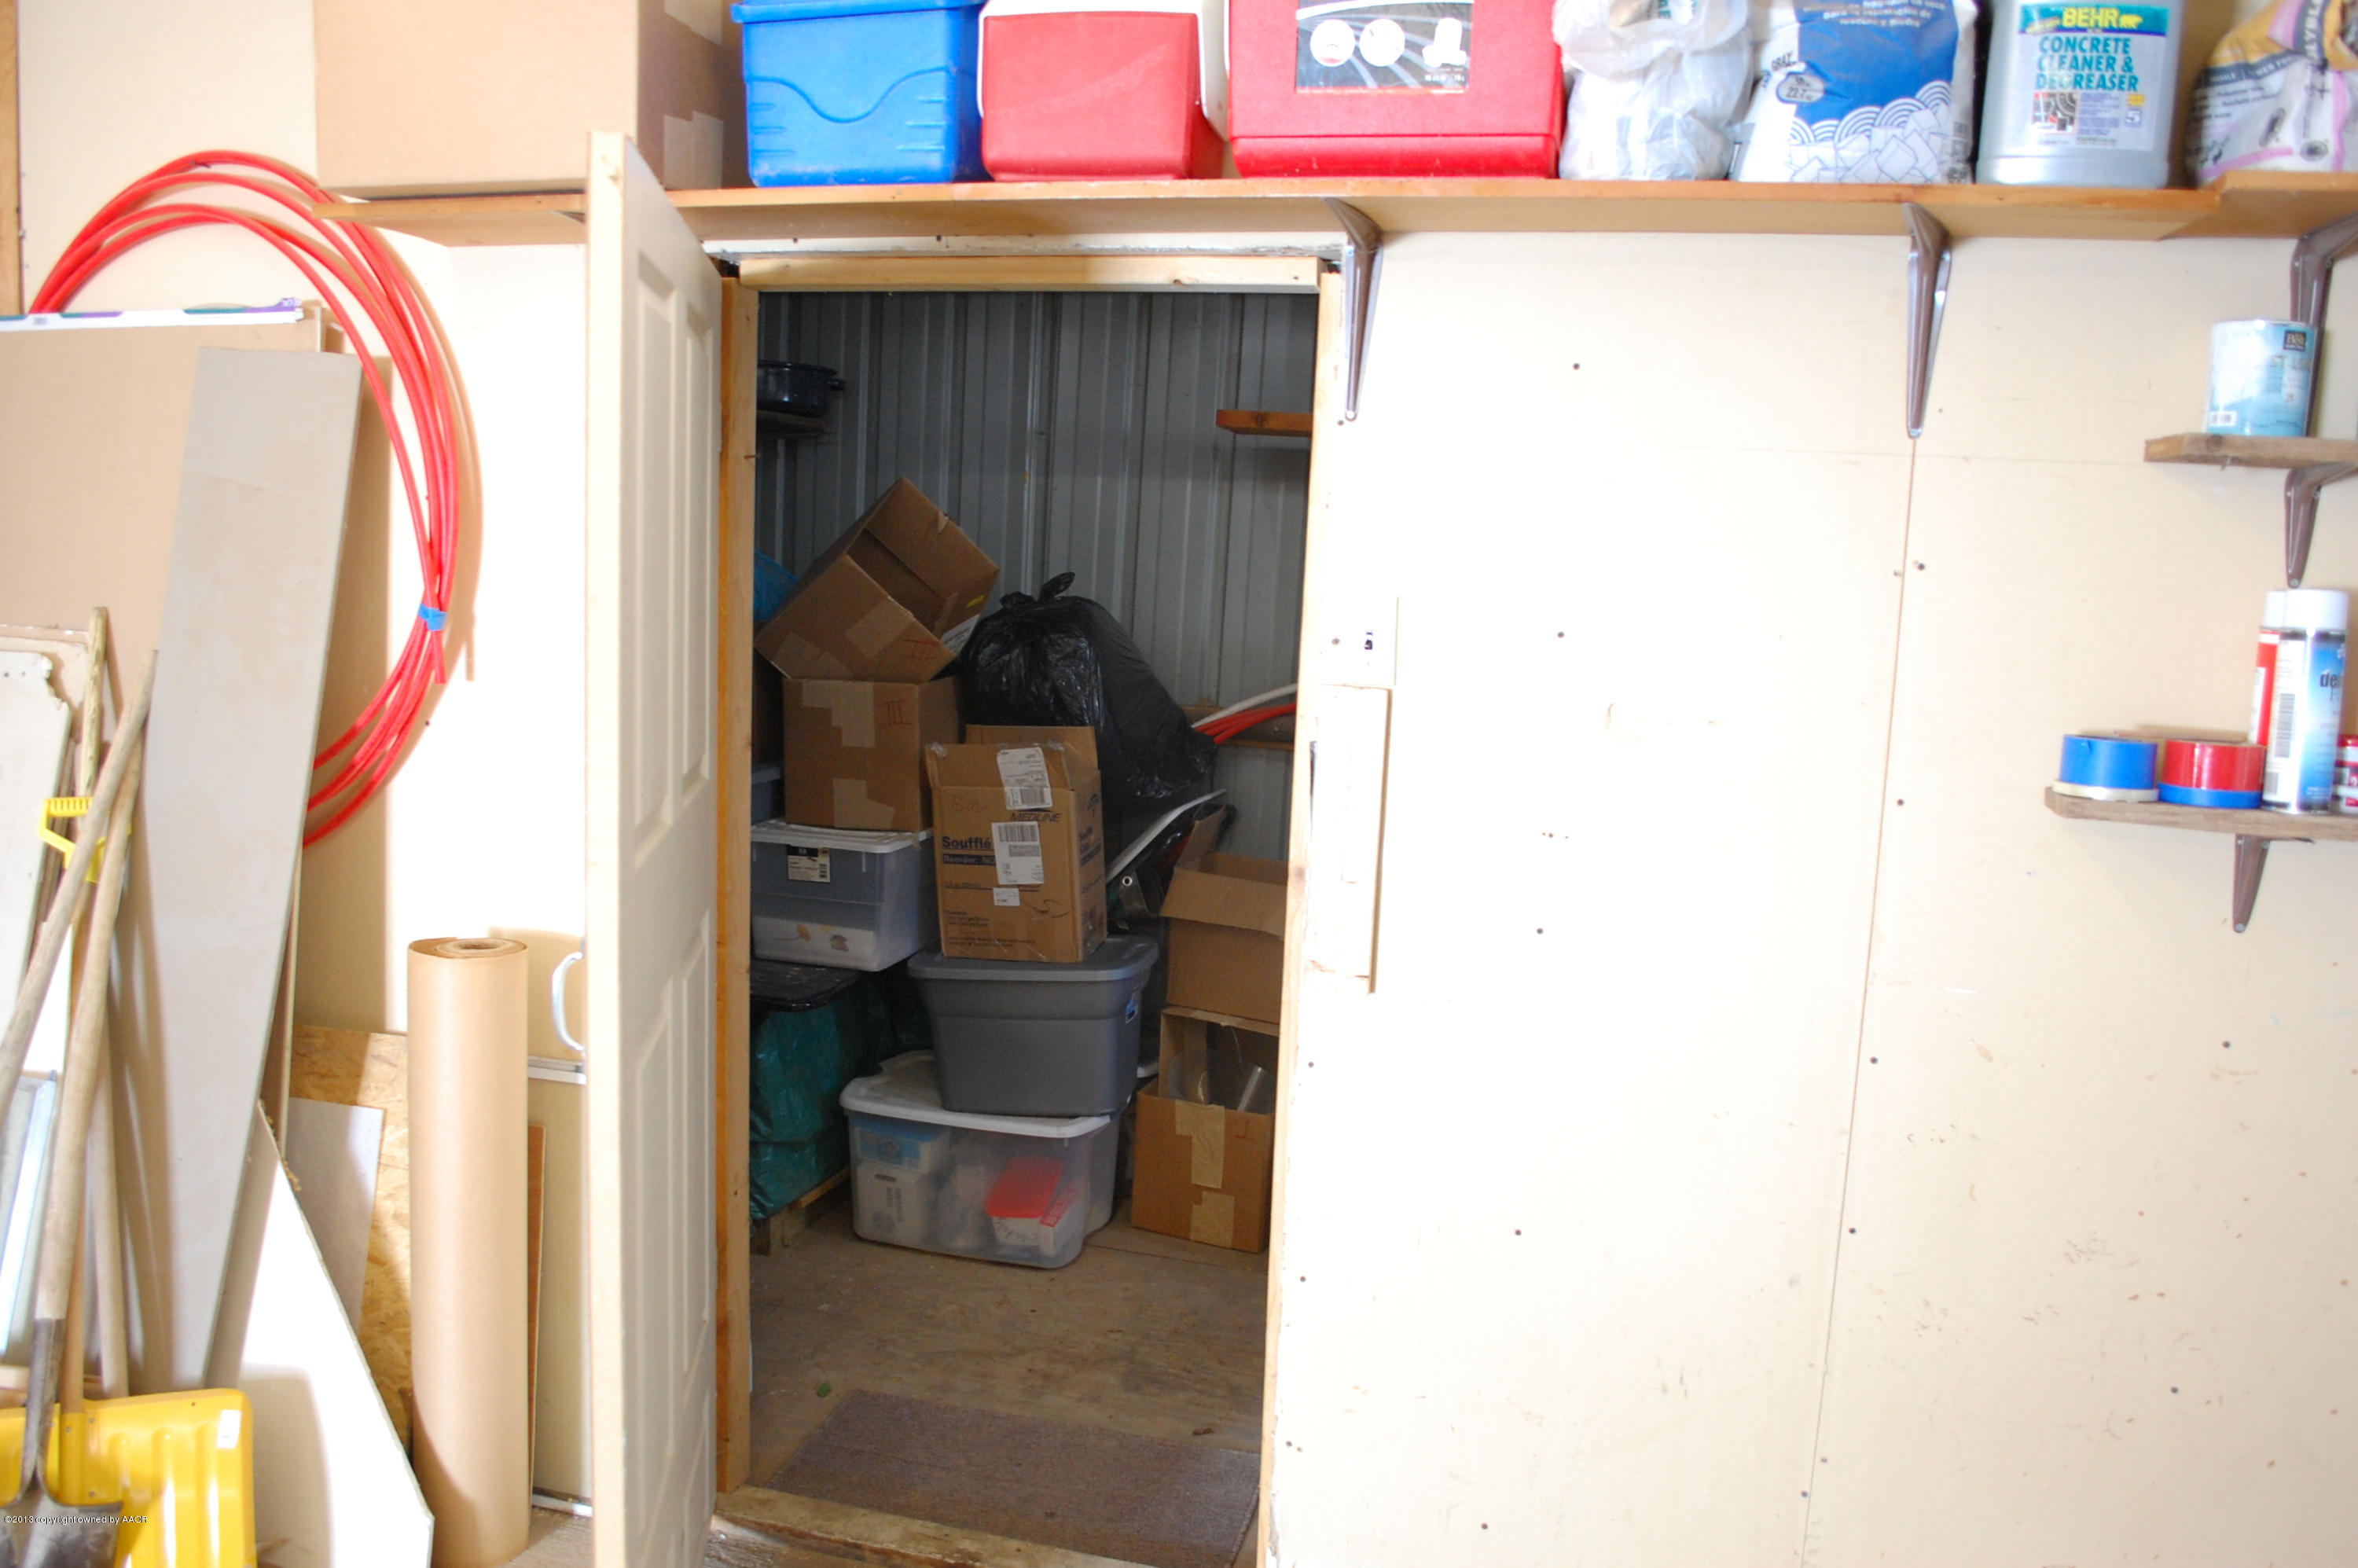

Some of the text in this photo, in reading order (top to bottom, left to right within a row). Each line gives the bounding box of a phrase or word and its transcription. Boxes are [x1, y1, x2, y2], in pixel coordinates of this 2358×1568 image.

[2062, 7, 2119, 28] BEHR
[2040, 37, 2131, 54] CONCRETE
[2037, 54, 2134, 73] CLEANER &
[2036, 72, 2139, 91] DEGREASER
[2125, 111, 2141, 123] 5
[1010, 813, 1060, 822] MEDLINE
[942, 835, 992, 849] Soufflé
